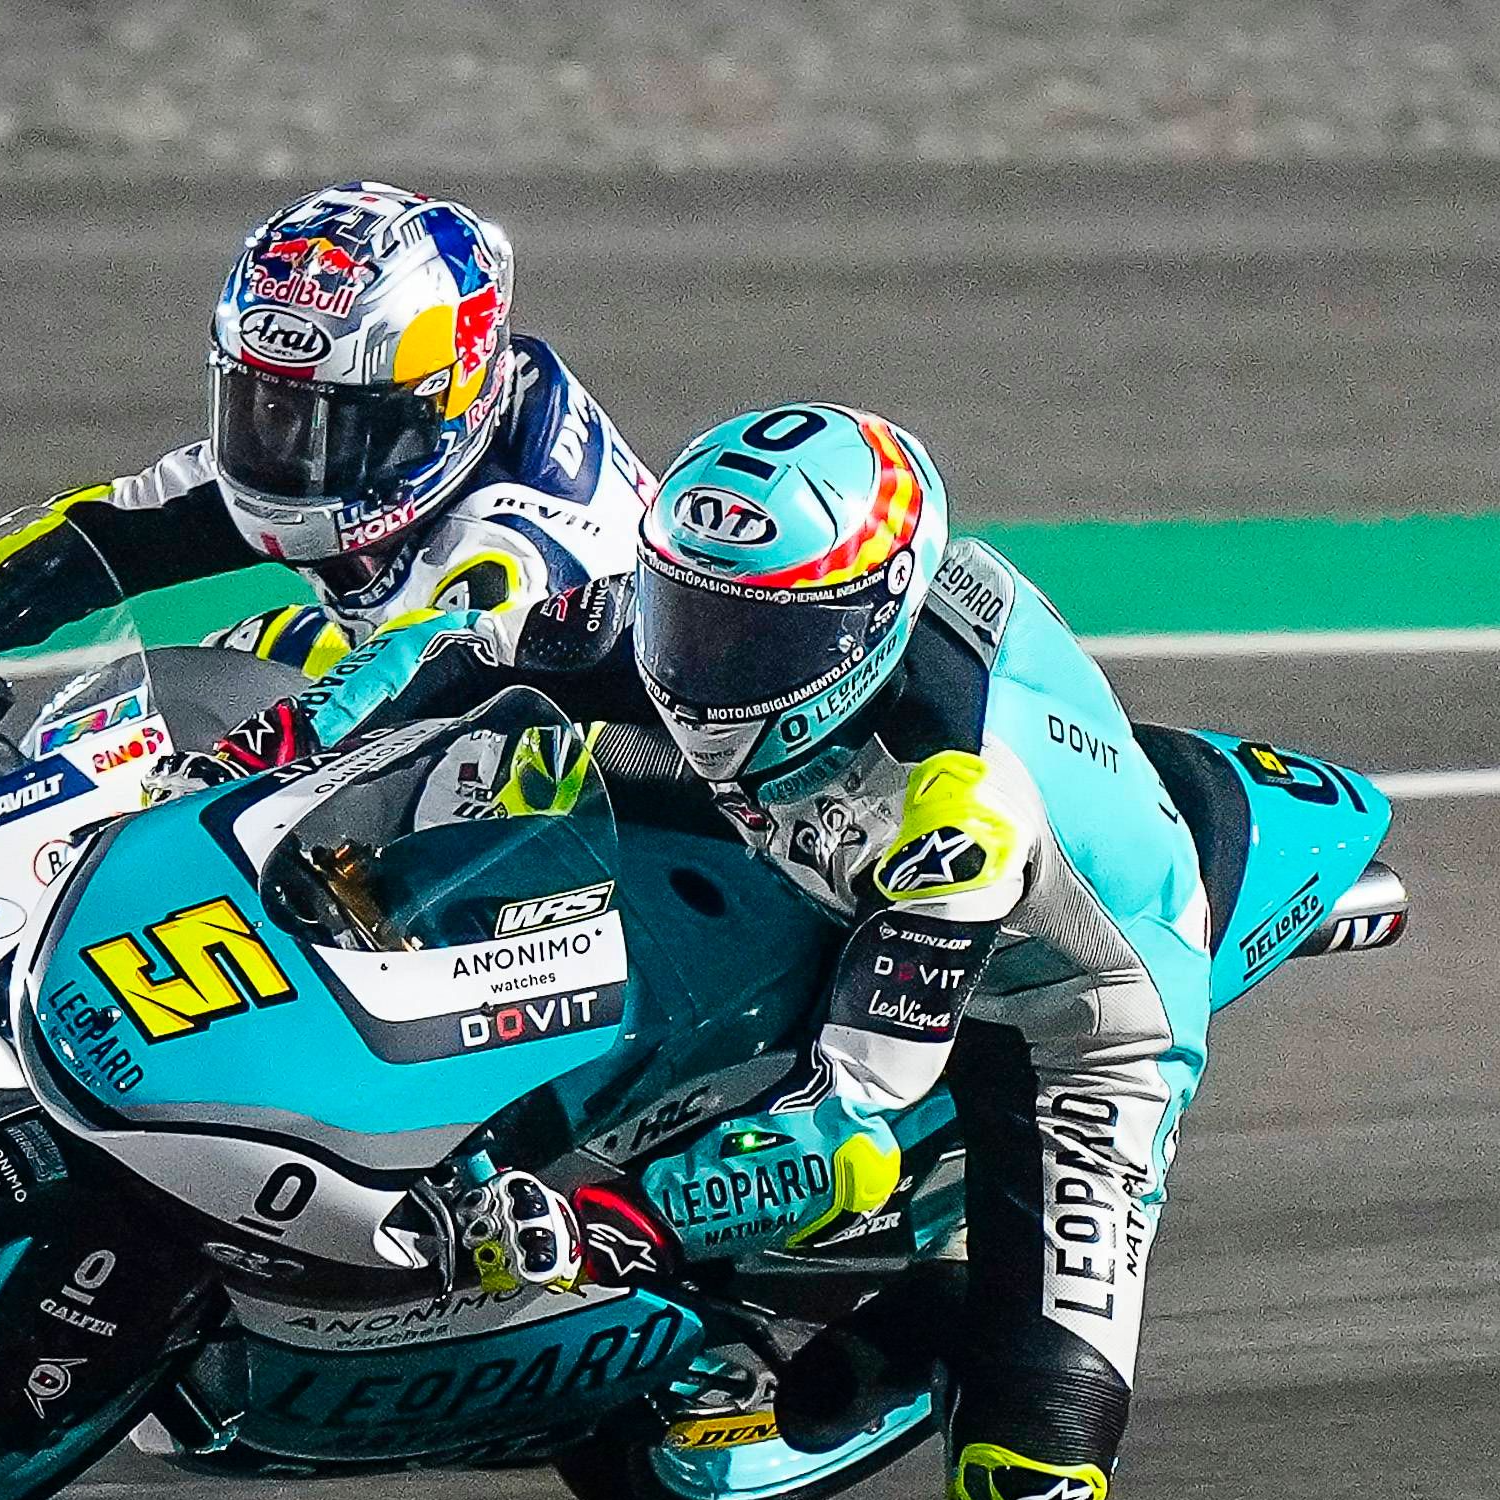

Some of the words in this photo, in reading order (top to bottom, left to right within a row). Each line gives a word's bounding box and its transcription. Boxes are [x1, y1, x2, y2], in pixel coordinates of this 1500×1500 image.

[251, 267, 299, 302] Red
[295, 280, 354, 315] Bull
[241, 313, 319, 353] Arai
[341, 501, 411, 550] MOLY
[676, 491, 769, 538] KYT
[934, 559, 1004, 623] EOPARD
[706, 657, 853, 720] MOTOABBIGLIAMENTO.IT
[815, 634, 898, 724] LEOPARD
[1048, 714, 1119, 773] DOVIT
[1251, 748, 1288, 775] 5
[499, 885, 610, 935] WRS
[1246, 894, 1319, 968] DELLORTO
[453, 934, 591, 979] ANONIMO
[900, 930, 972, 950] DUNLOP
[81, 896, 297, 1044] 5
[490, 971, 556, 993] watches
[460, 992, 598, 1047] DOVIT
[662, 1154, 831, 1229] LEOPARD
[40, 1299, 117, 1337] GALFER
[266, 1307, 684, 1427] LEOPARD
